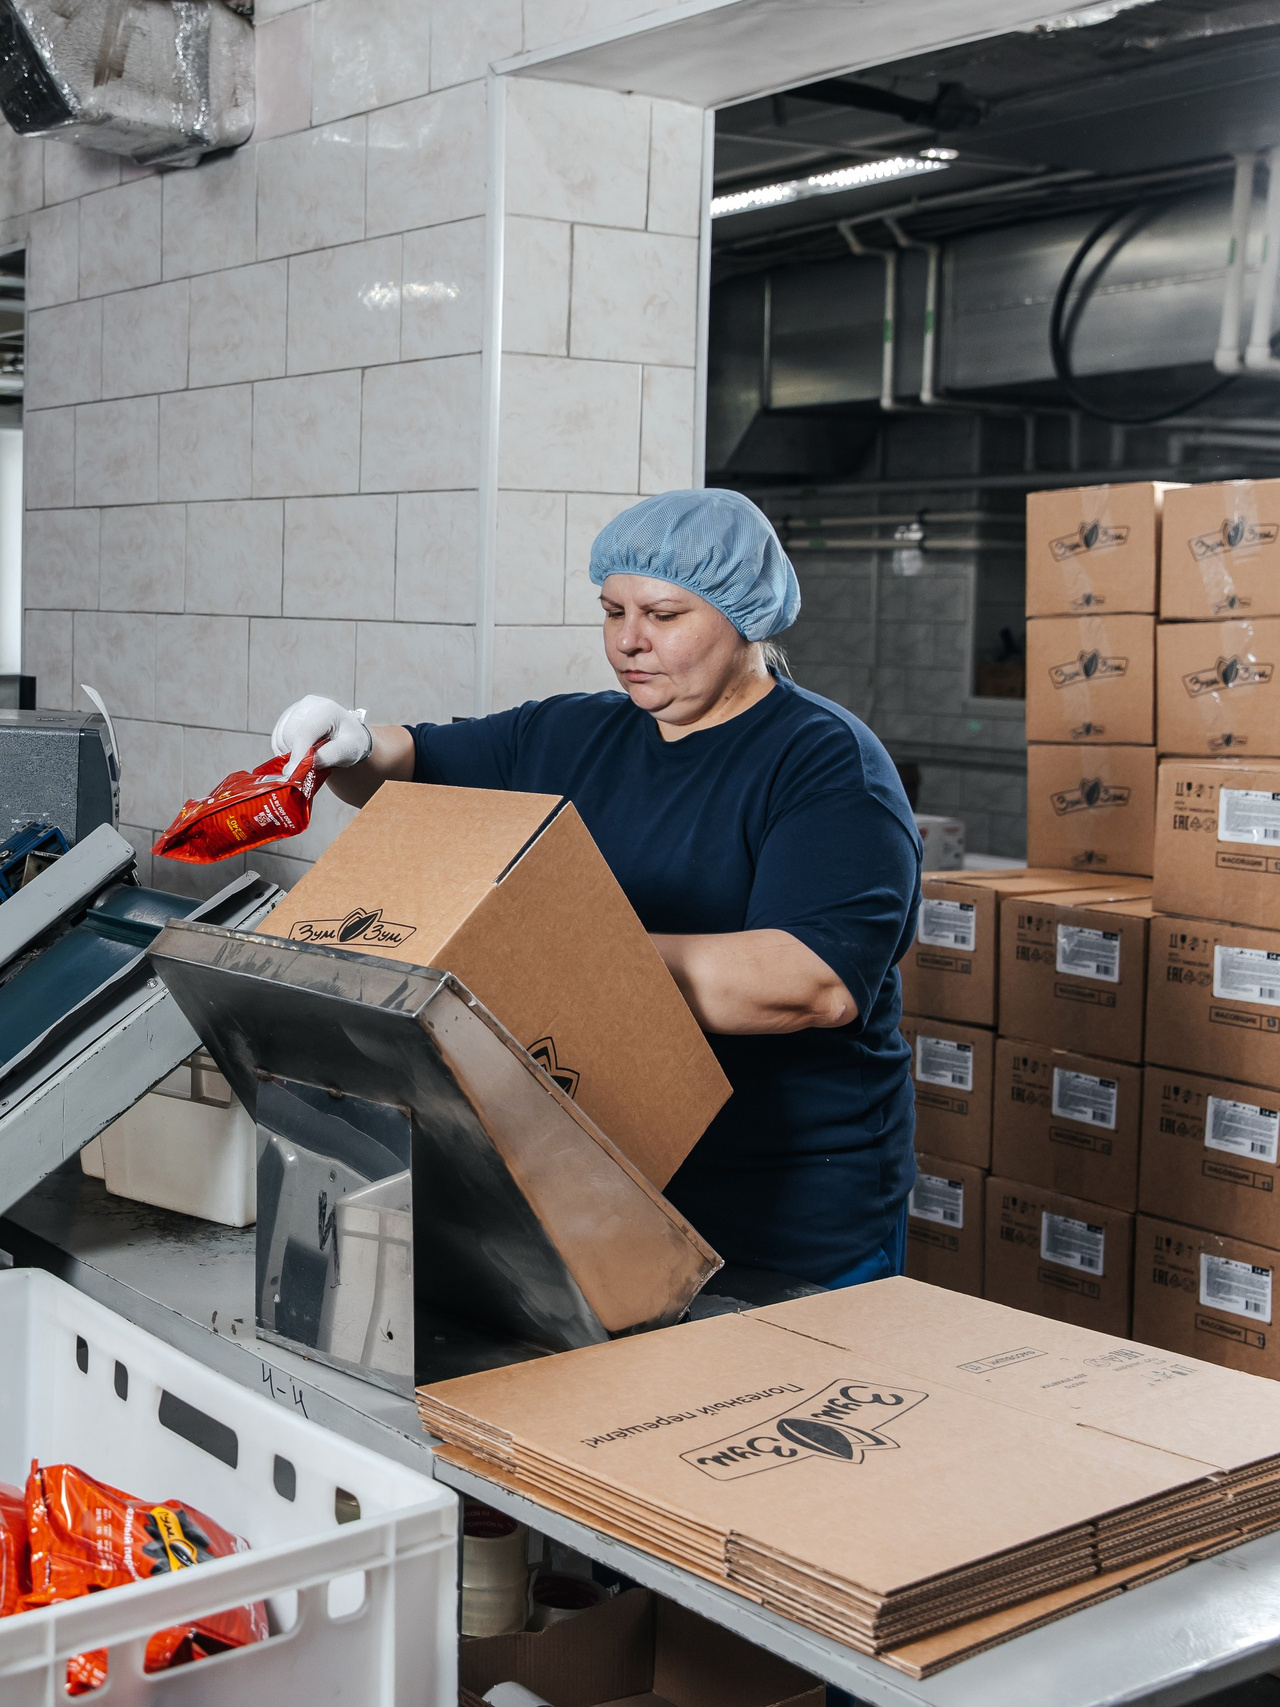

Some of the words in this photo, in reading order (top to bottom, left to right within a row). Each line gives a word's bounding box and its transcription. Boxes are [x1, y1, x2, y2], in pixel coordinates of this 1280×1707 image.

[298, 924, 336, 942] Зум
[363, 924, 402, 943] Зум
[696, 1382, 805, 1417] Полезный
[811, 1385, 904, 1421] Зум
[580, 1410, 698, 1449] перещёлк!
[696, 1436, 799, 1467] Зум
